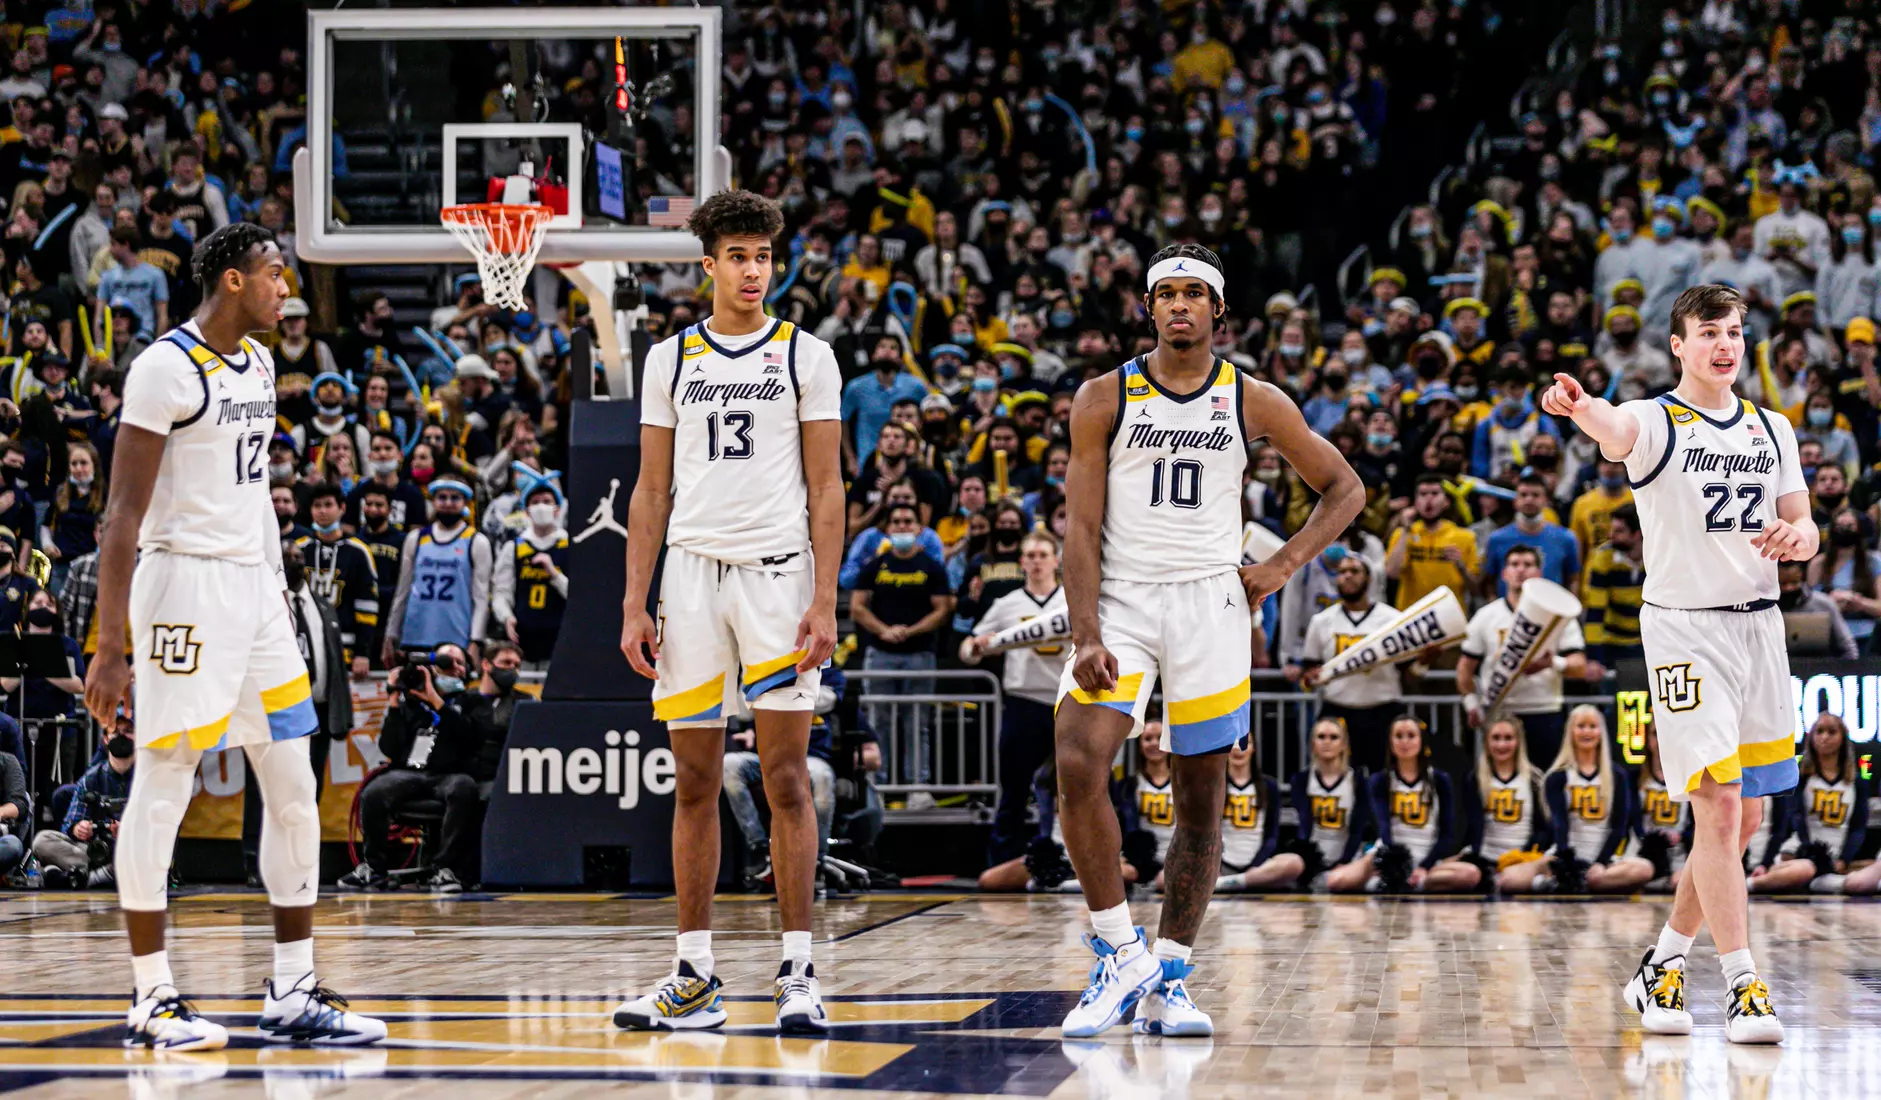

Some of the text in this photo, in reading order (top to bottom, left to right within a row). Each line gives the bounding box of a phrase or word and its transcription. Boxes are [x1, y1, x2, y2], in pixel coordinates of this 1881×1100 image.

[681, 378, 786, 407] Marquette
[707, 410, 754, 461] 13
[1126, 424, 1233, 454] Marquette
[235, 431, 265, 485] 12
[1682, 447, 1775, 478] Marquette
[1150, 458, 1204, 509] 10
[1702, 483, 1765, 532] 22
[419, 574, 456, 601] 32
[528, 584, 547, 610] 0
[148, 622, 204, 676] MU
[1381, 611, 1446, 656] RING
[1654, 662, 1703, 713] MU
[1791, 674, 1881, 743] OU
[508, 729, 677, 810] meije
[1140, 791, 1174, 826] MU
[1311, 795, 1347, 829] MU
[1391, 791, 1431, 828] MU
[1485, 788, 1524, 824] MU
[1811, 788, 1849, 826] MU
